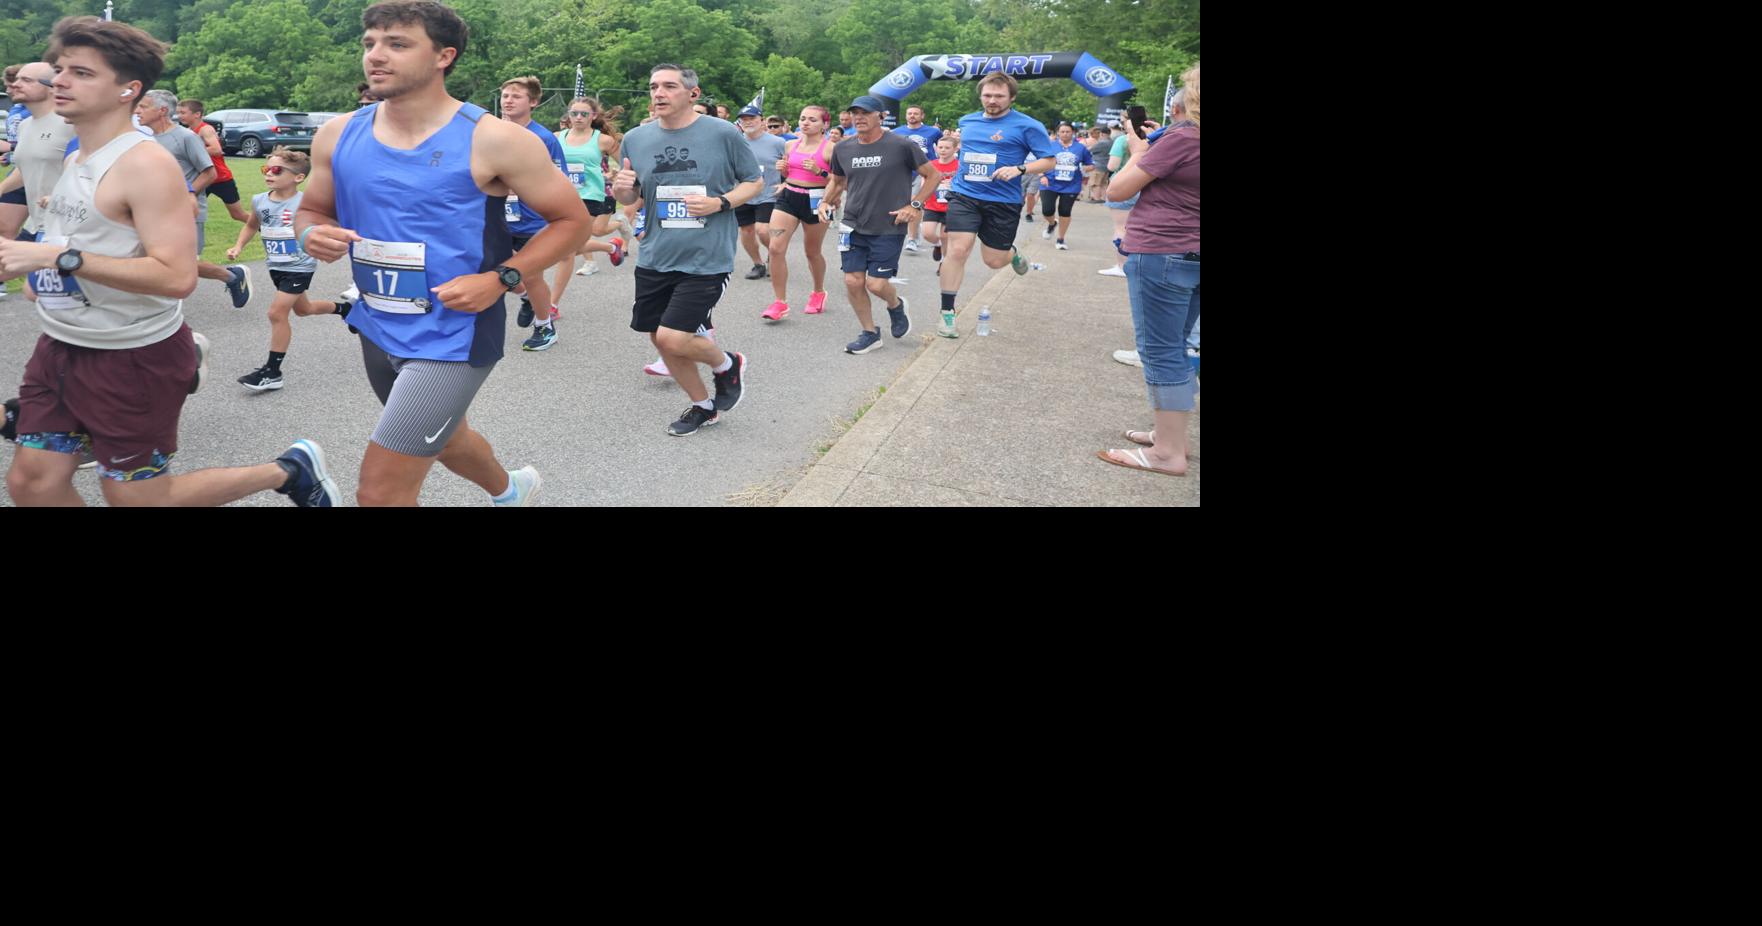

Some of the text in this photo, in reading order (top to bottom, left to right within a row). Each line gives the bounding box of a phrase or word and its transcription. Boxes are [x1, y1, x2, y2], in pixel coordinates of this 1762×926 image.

[943, 55, 1052, 76] START
[968, 163, 988, 175] 580
[667, 202, 693, 218] 95
[266, 240, 287, 254] 521
[35, 268, 65, 292] 269
[372, 269, 399, 296] 17
